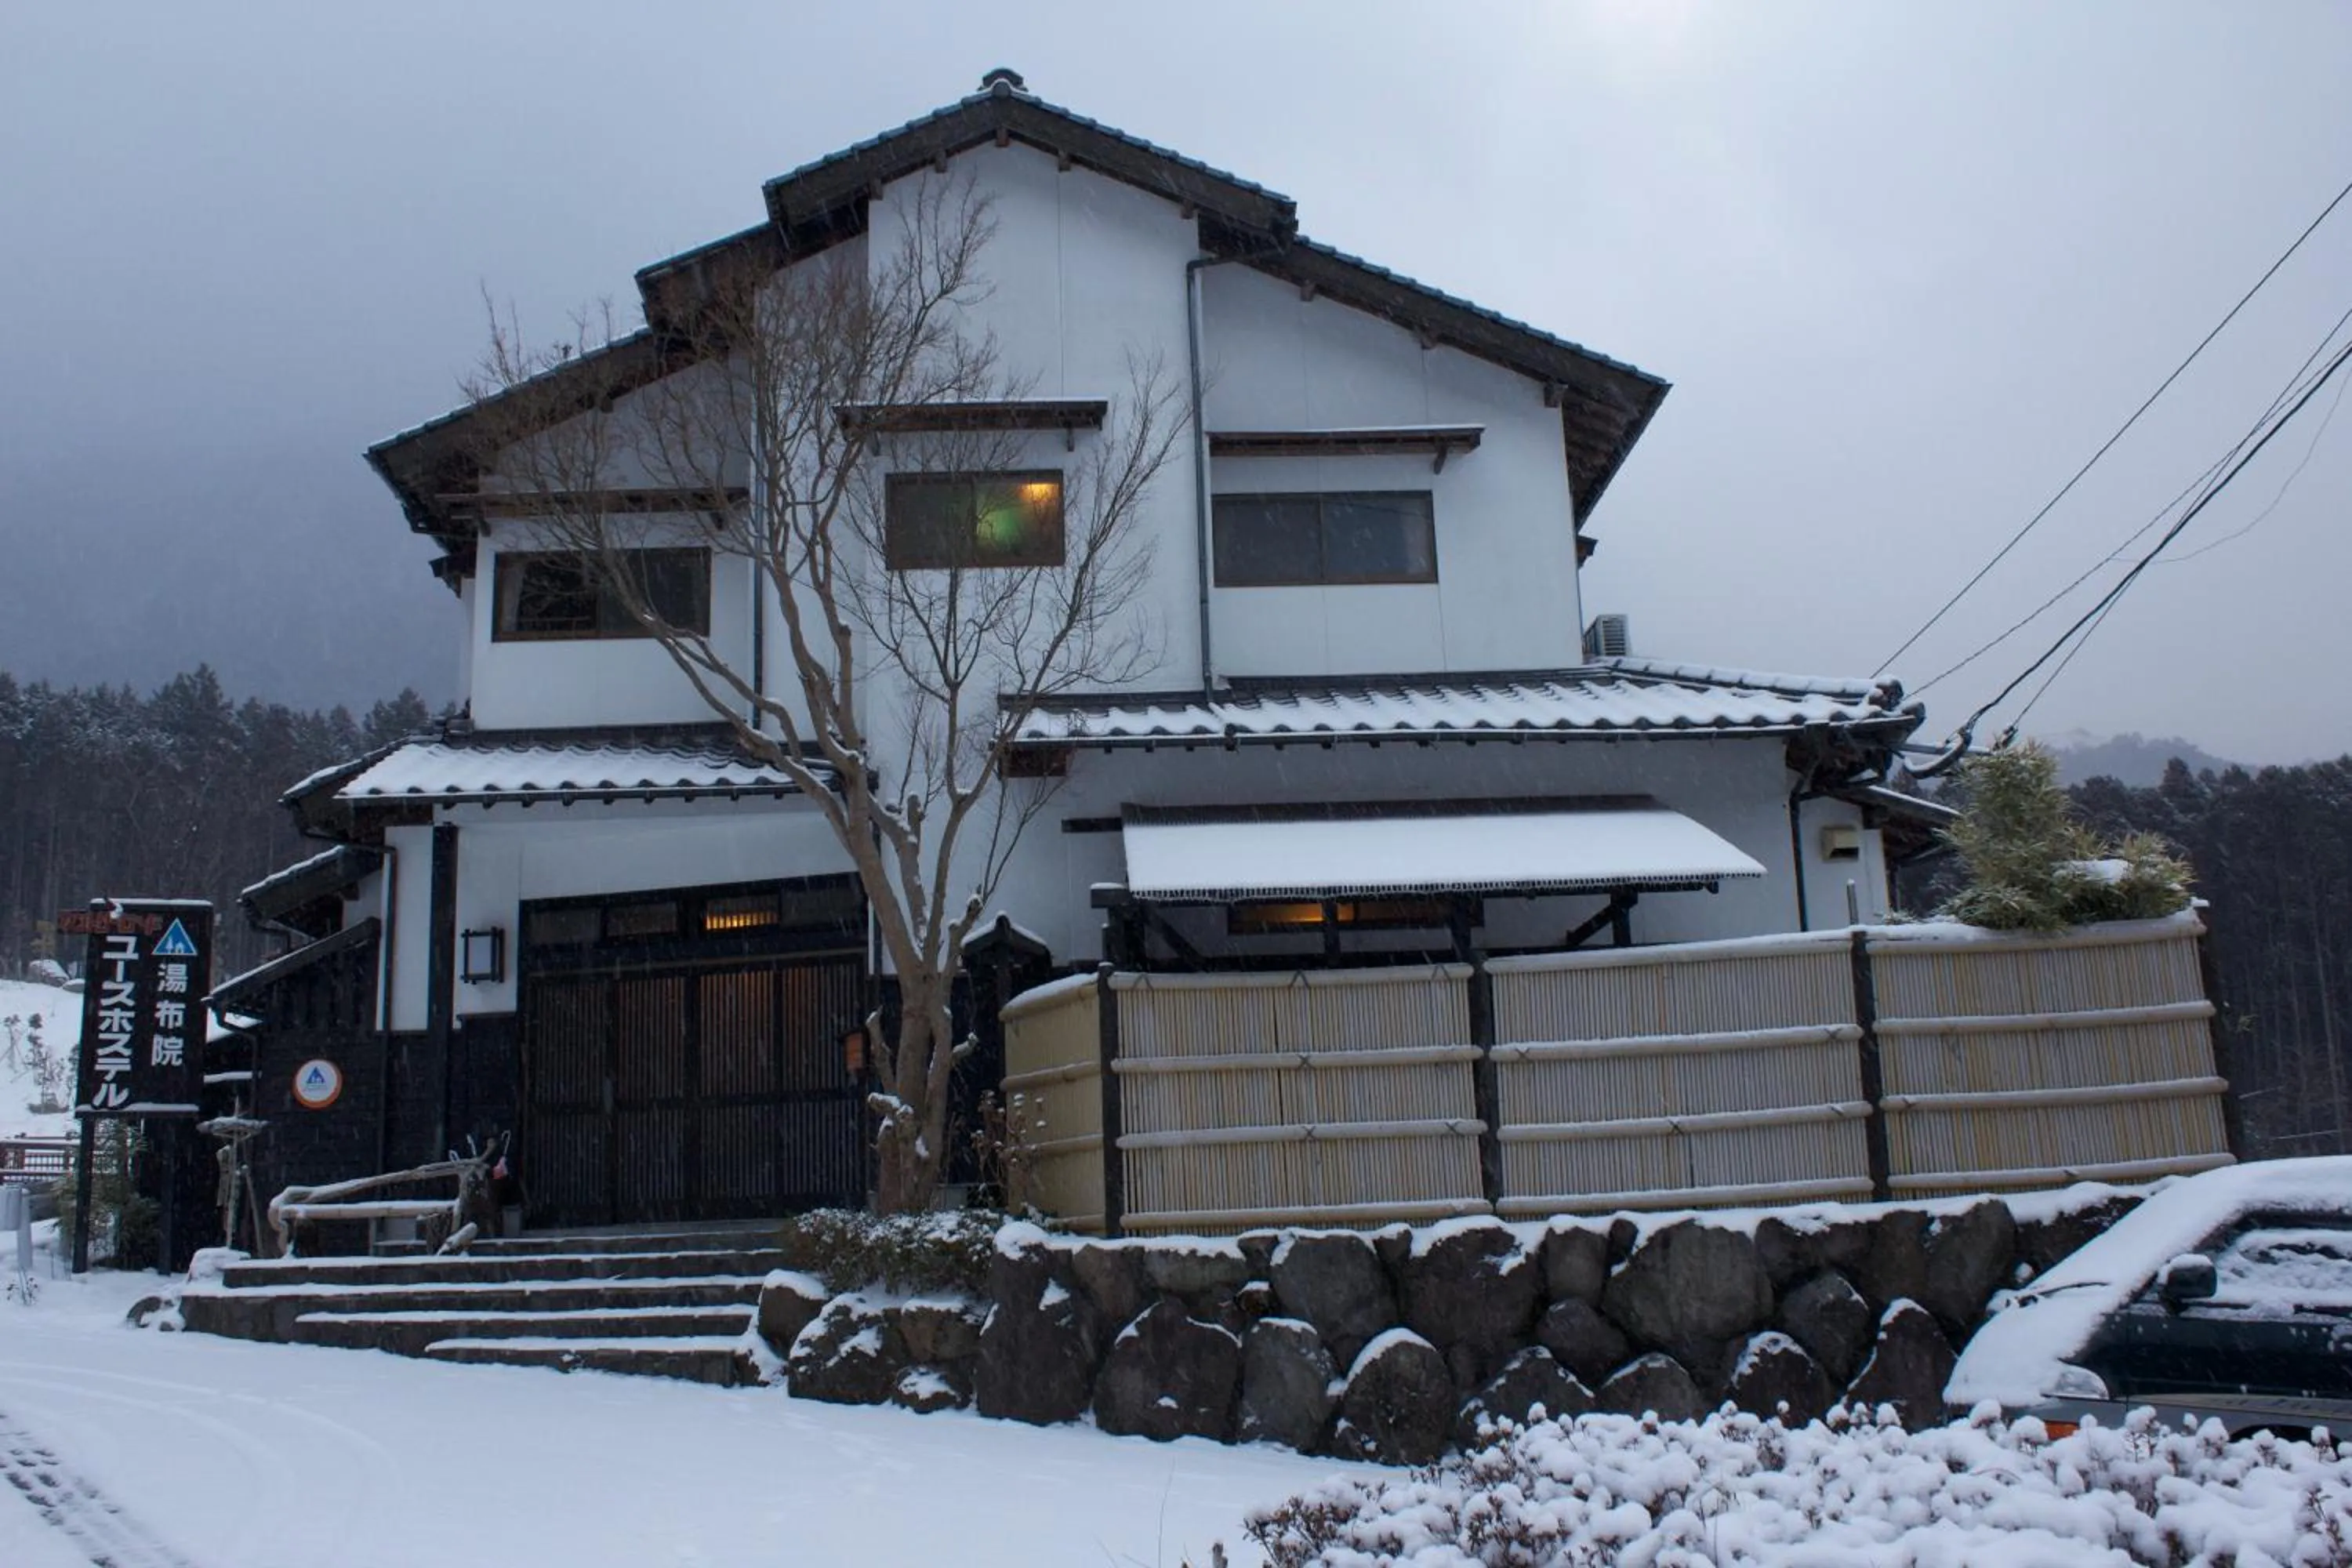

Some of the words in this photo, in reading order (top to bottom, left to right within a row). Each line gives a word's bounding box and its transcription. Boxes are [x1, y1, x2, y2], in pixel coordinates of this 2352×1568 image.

[91, 935, 139, 1108] ユースホステル
[151, 963, 188, 1066] 湯布院
